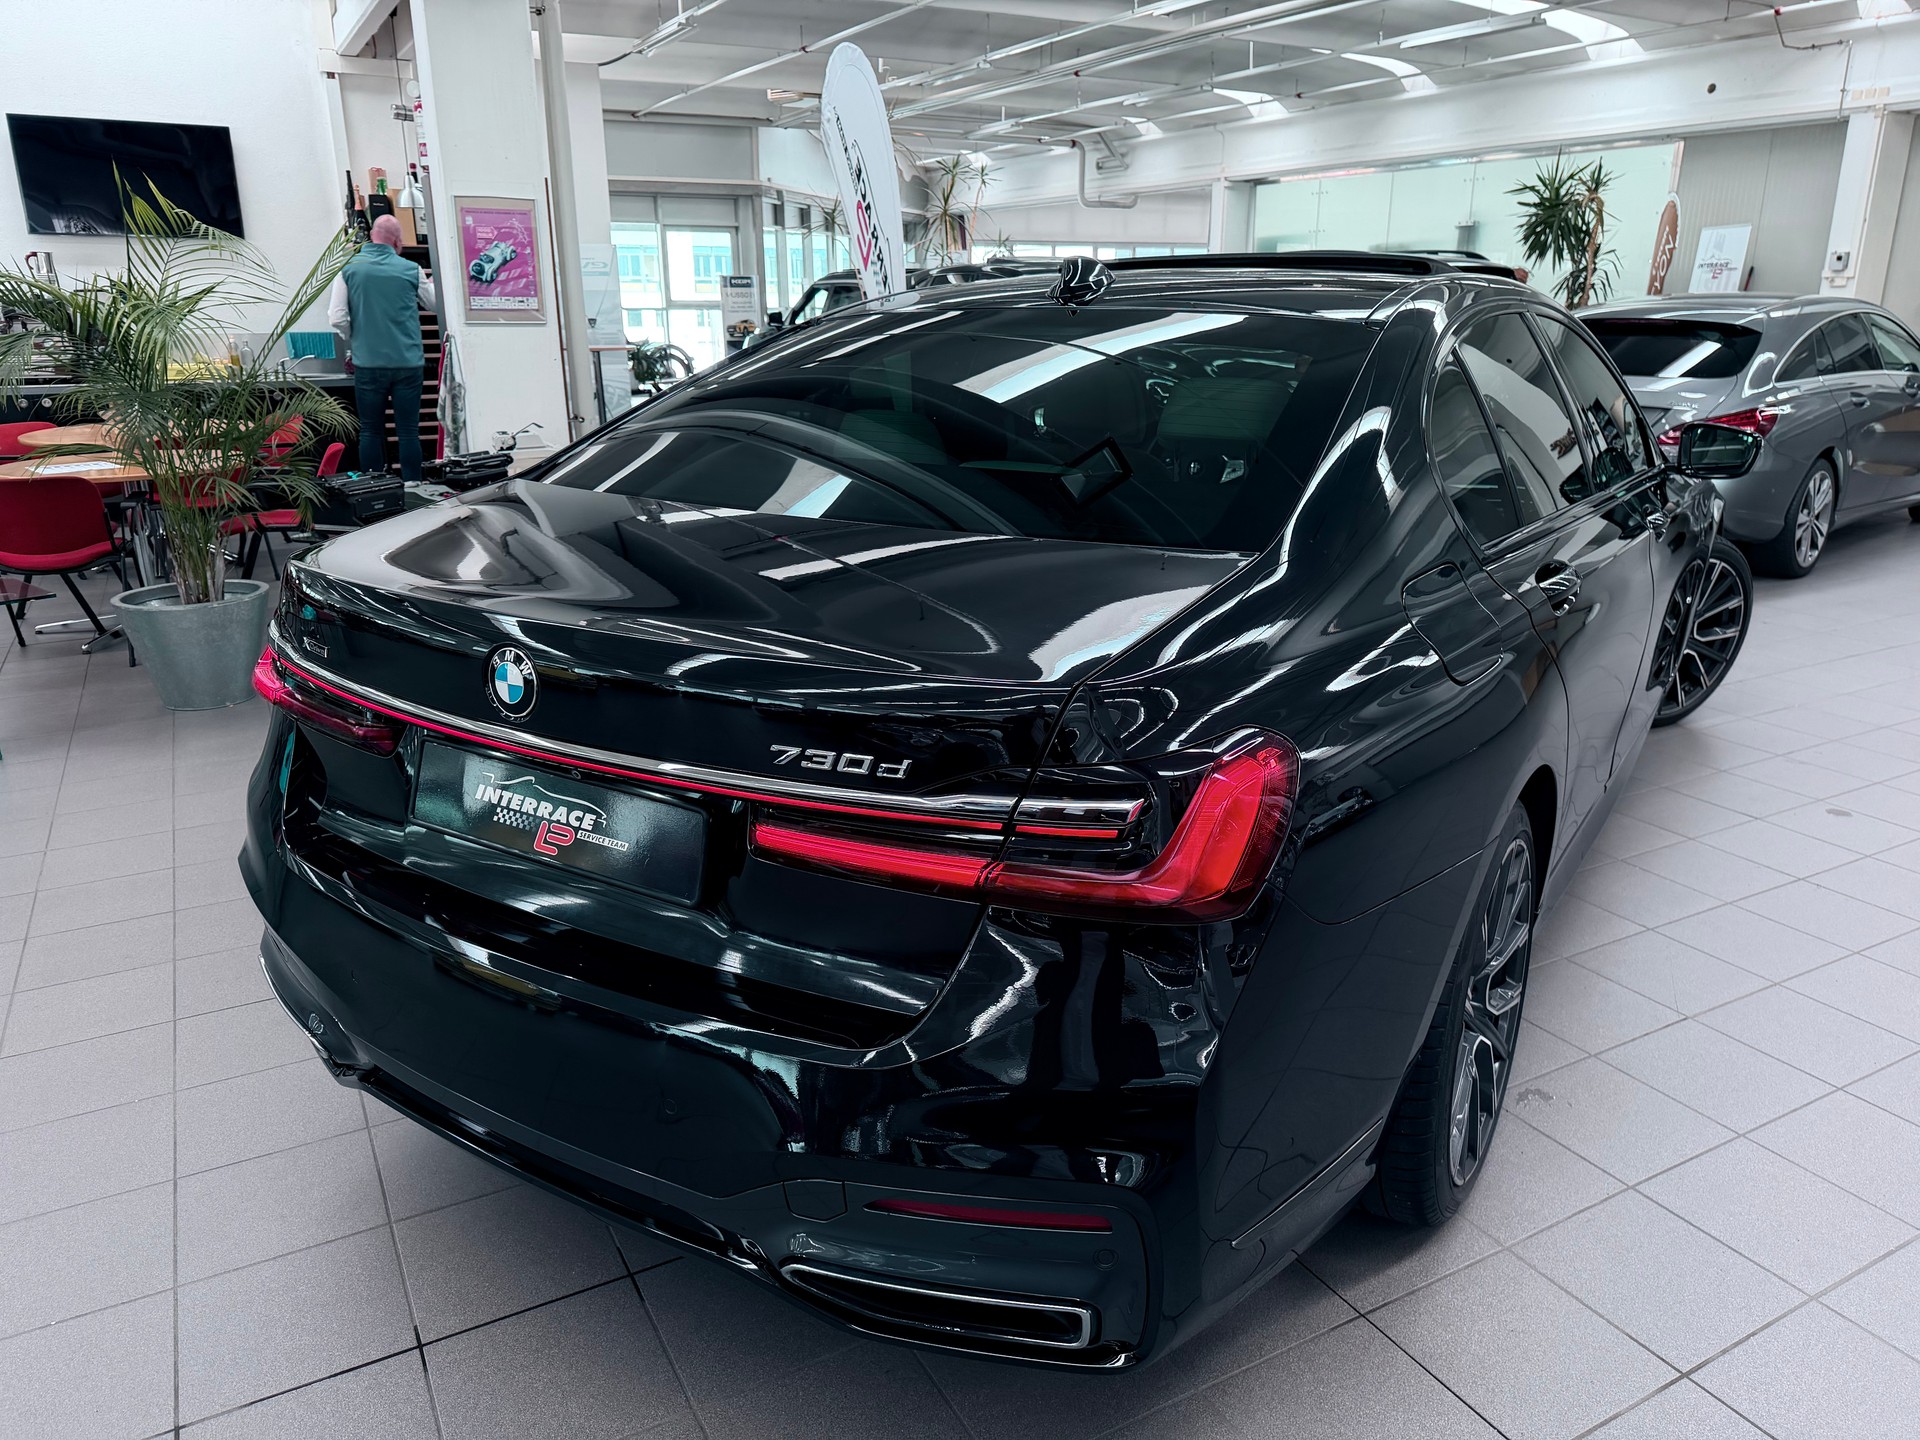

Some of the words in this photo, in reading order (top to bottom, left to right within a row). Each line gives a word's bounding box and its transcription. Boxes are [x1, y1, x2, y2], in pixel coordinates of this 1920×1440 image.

[493, 650, 531, 675] BMW
[770, 744, 912, 779] 730d
[475, 784, 597, 830] INTERRACE
[579, 831, 606, 846] SERVICE
[606, 838, 627, 850] TEAM
